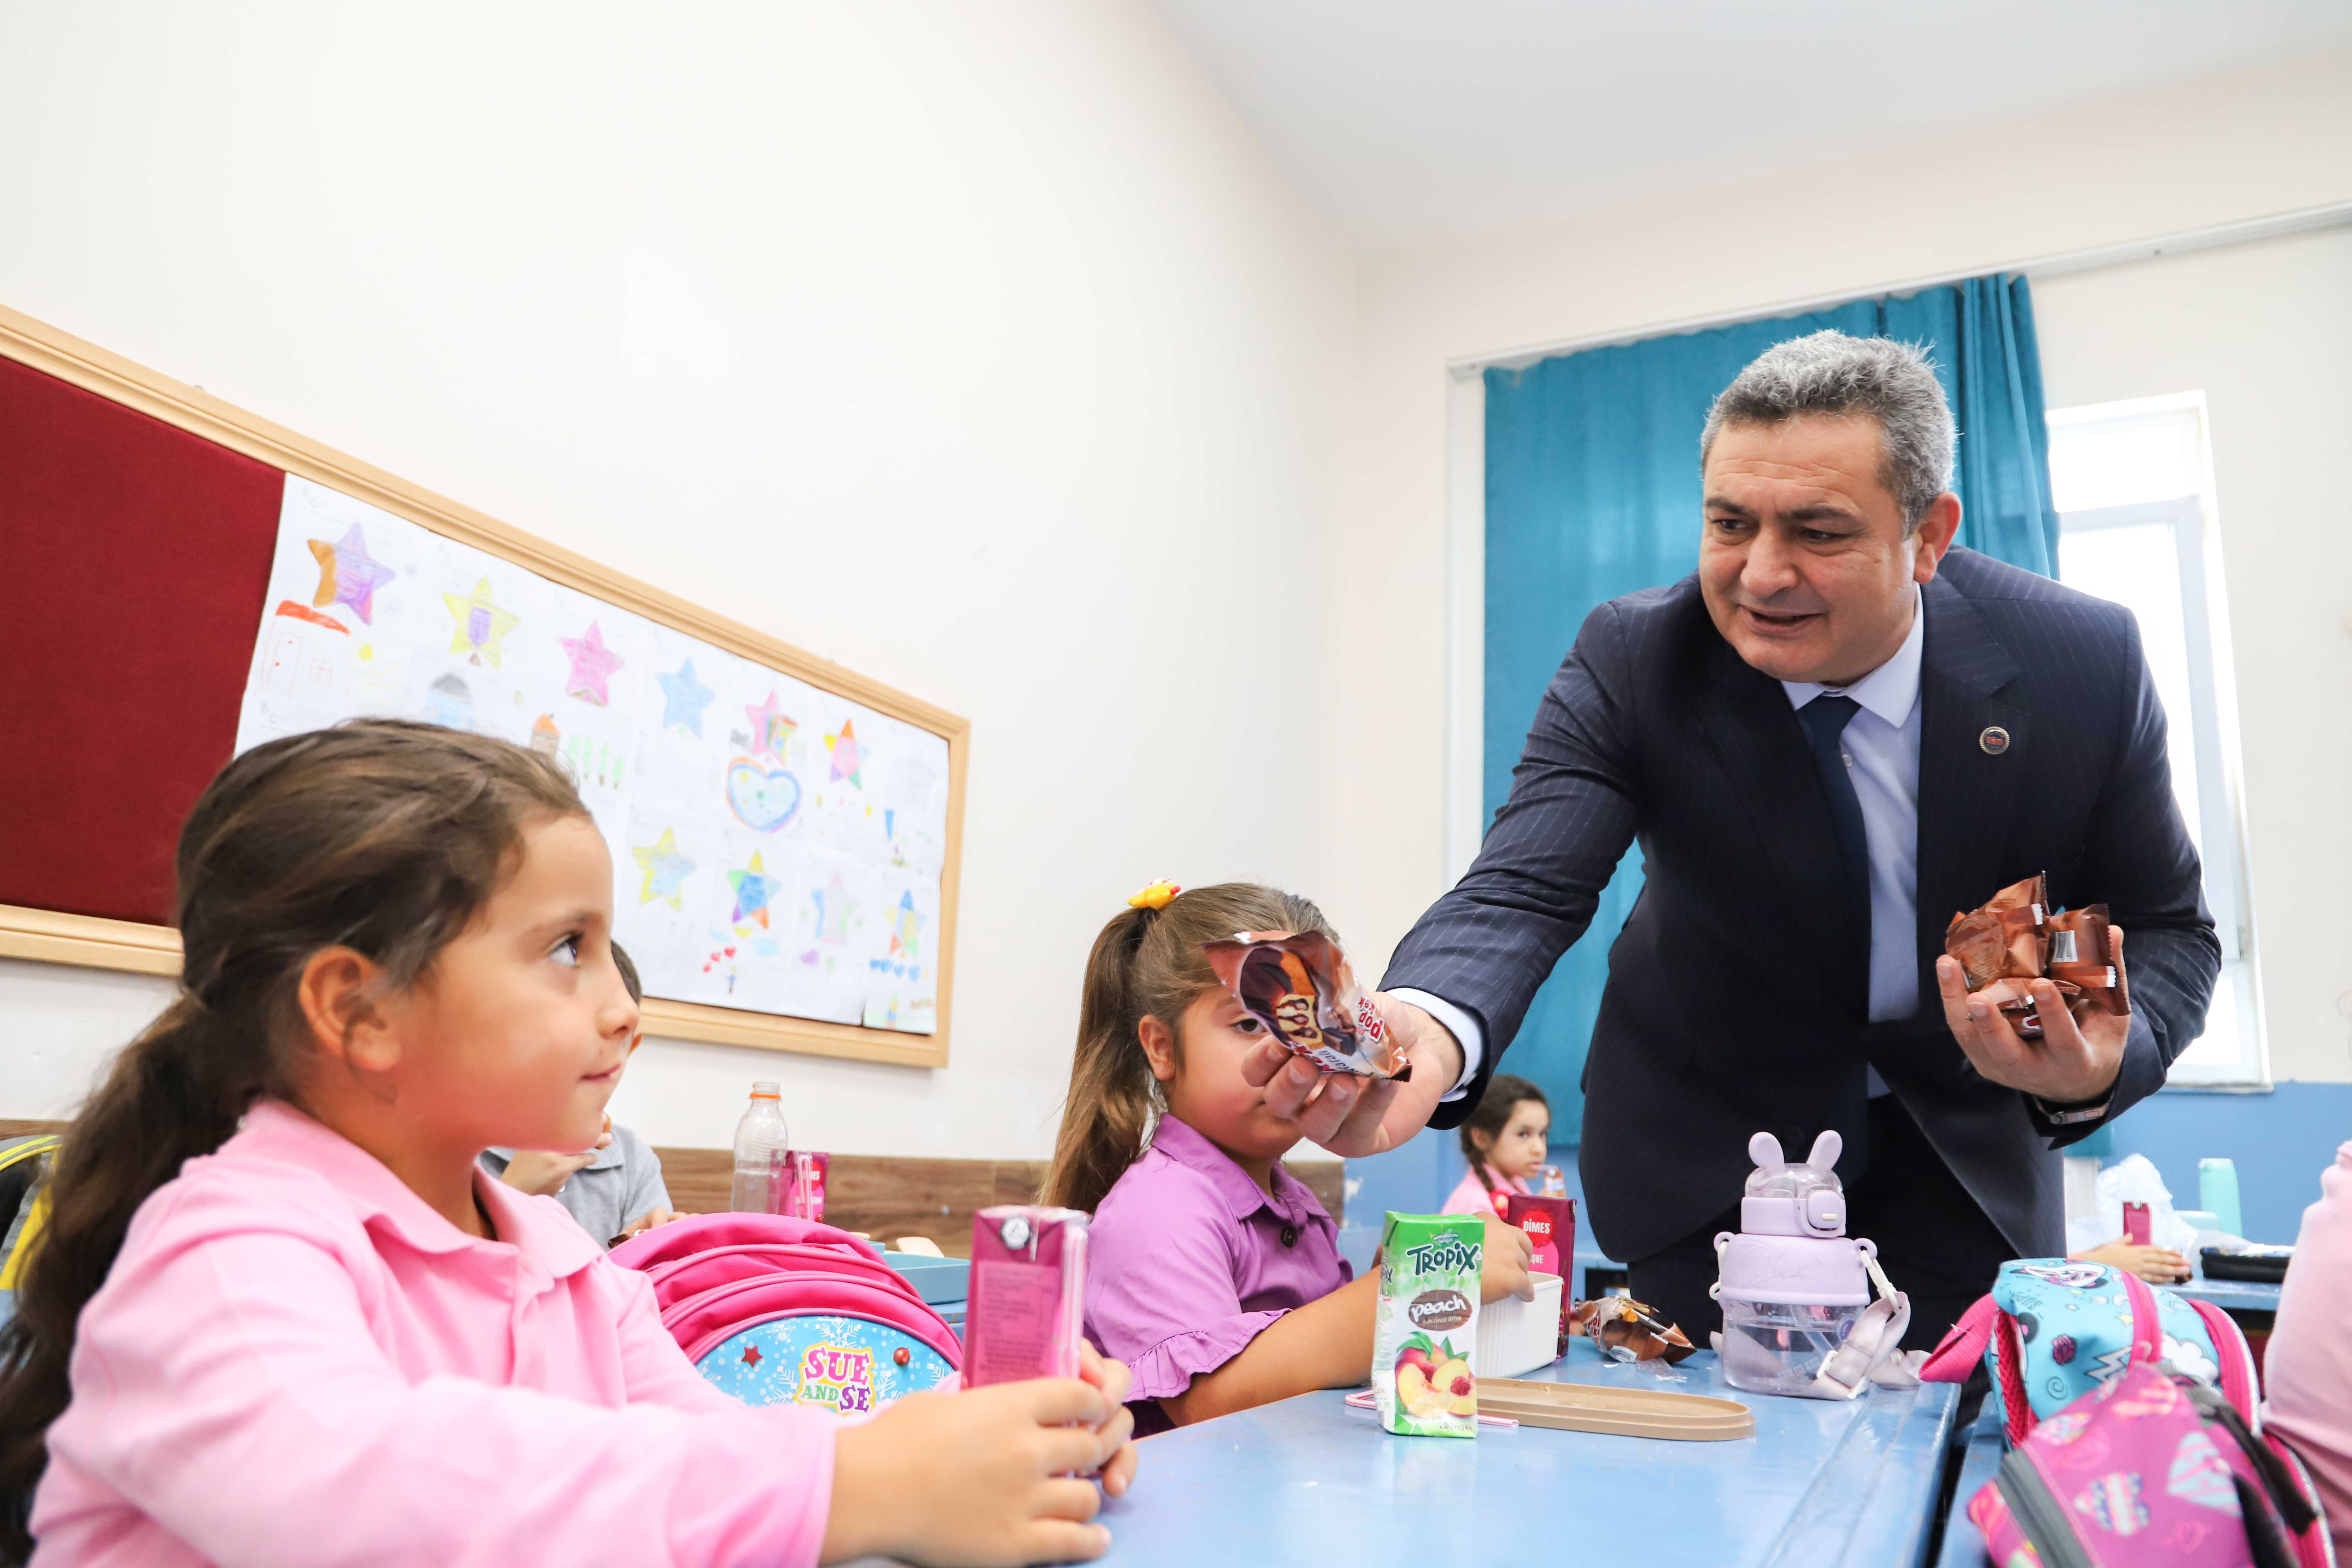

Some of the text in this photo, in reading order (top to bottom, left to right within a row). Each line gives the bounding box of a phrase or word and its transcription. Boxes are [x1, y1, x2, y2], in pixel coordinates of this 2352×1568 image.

[1358, 1011, 1383, 1040] pop
[1523, 1218, 1550, 1234] DİMES
[1411, 1294, 1467, 1322] peach
[804, 1347, 870, 1386] SUE
[801, 1384, 871, 1413] AND SE
